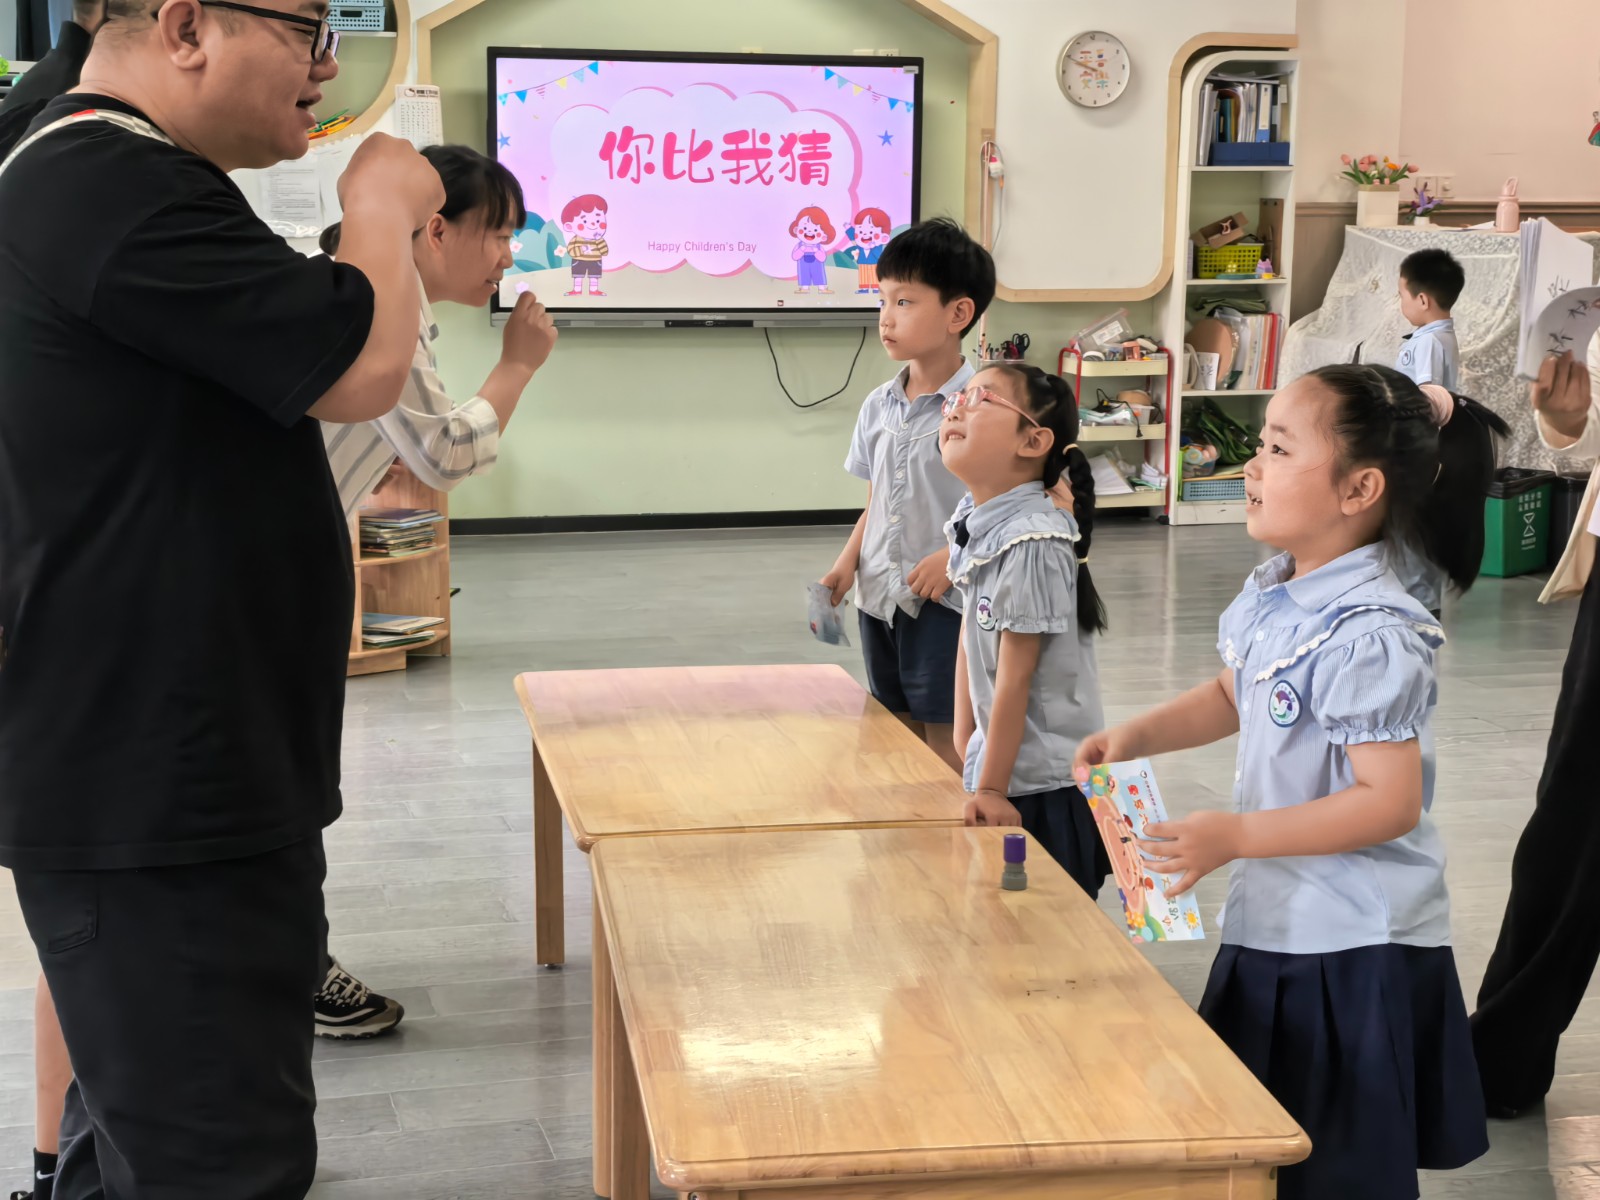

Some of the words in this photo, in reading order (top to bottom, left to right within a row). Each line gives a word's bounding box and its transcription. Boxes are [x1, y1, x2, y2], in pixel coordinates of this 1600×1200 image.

[599, 125, 832, 187] 你比我猜
[647, 240, 681, 254] Happy
[684, 240, 734, 252] Children's
[737, 241, 757, 254] Day
